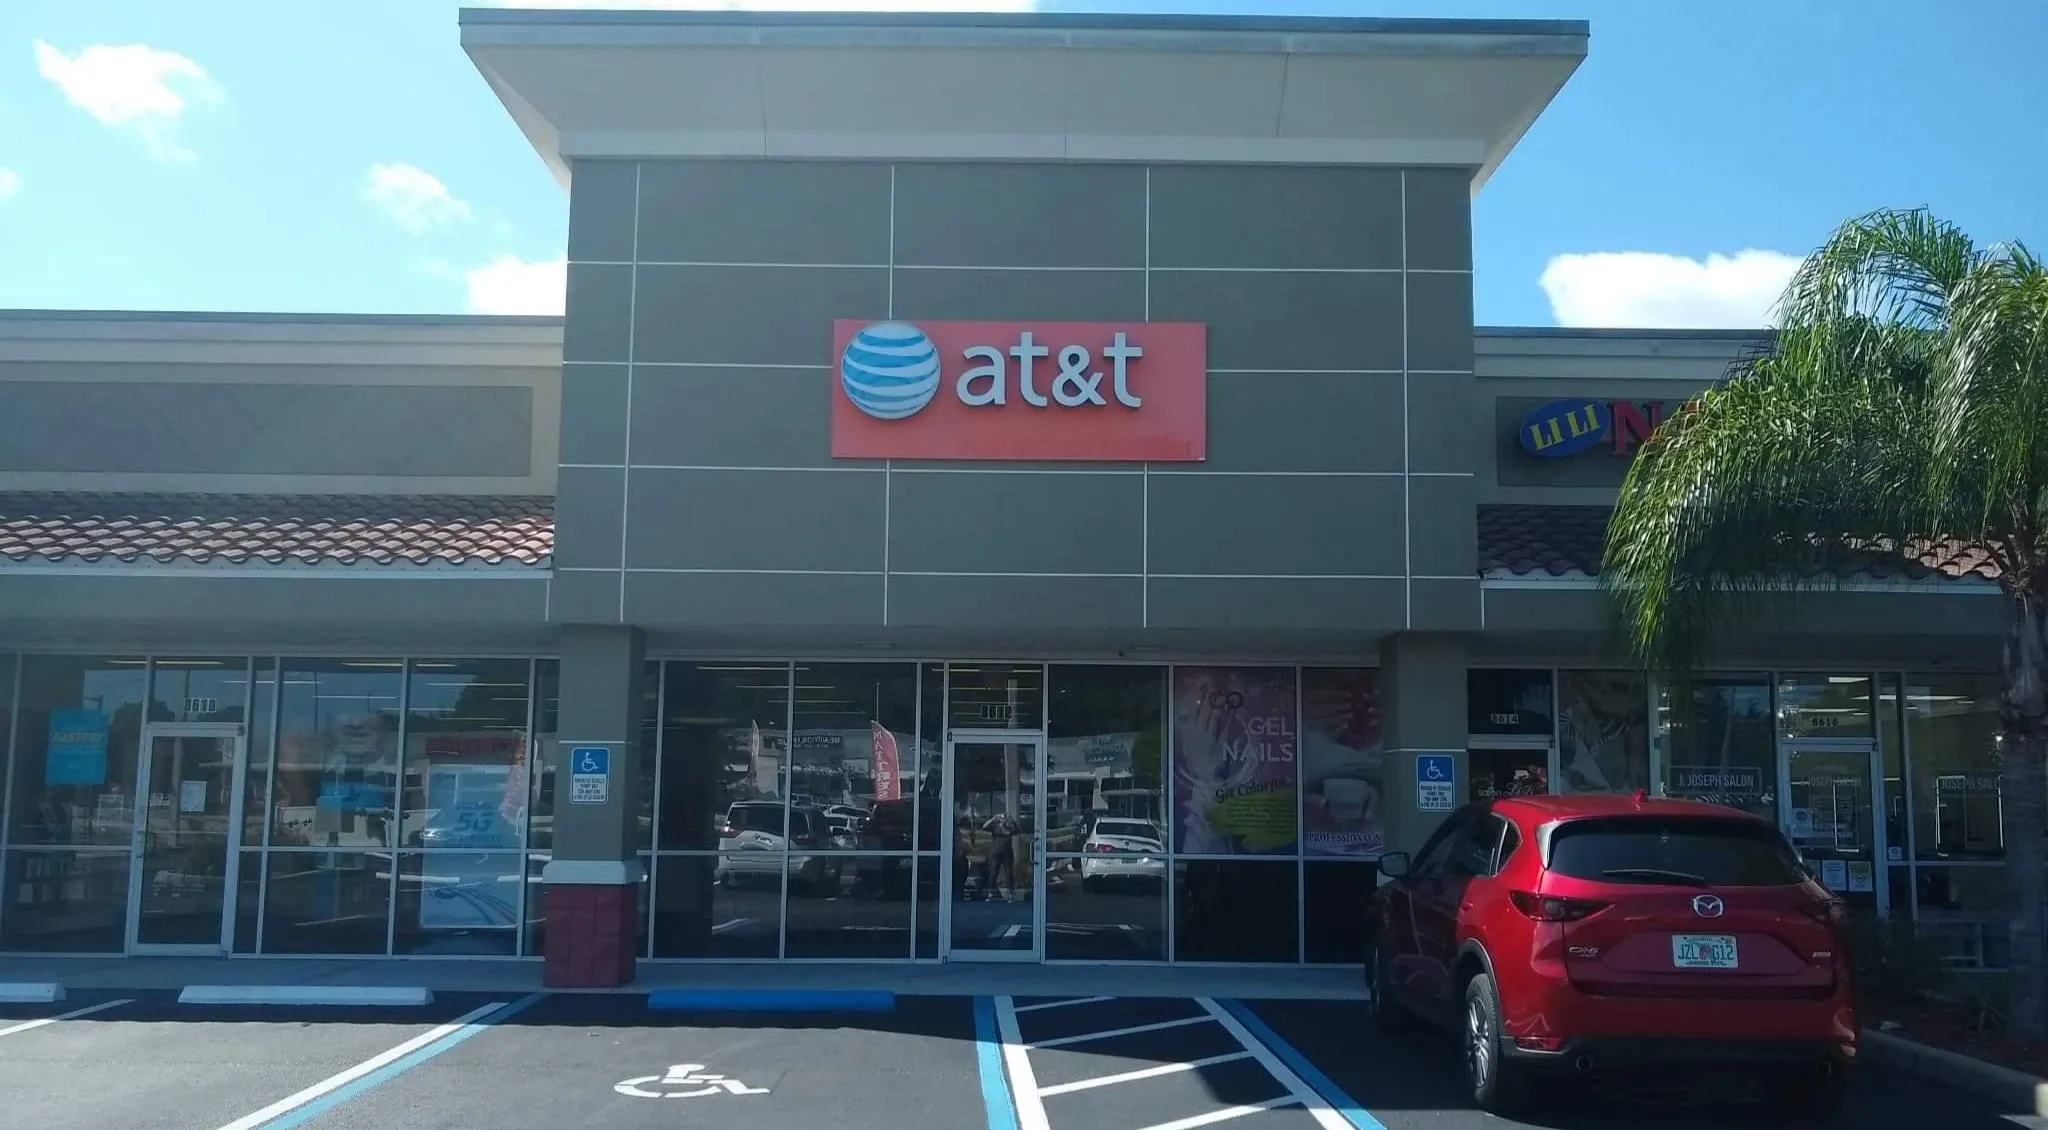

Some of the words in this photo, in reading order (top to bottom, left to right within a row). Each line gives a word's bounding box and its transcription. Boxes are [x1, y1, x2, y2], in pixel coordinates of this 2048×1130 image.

[956, 331, 1142, 408] at&t
[1248, 717, 1294, 736] GEL
[1811, 717, 1839, 728] 8616
[1222, 740, 1294, 762] NAILS
[1687, 773, 1722, 787] JOSEPH
[1723, 773, 1755, 787] SALON
[455, 811, 493, 832] 5G
[1678, 944, 1698, 960] JZL
